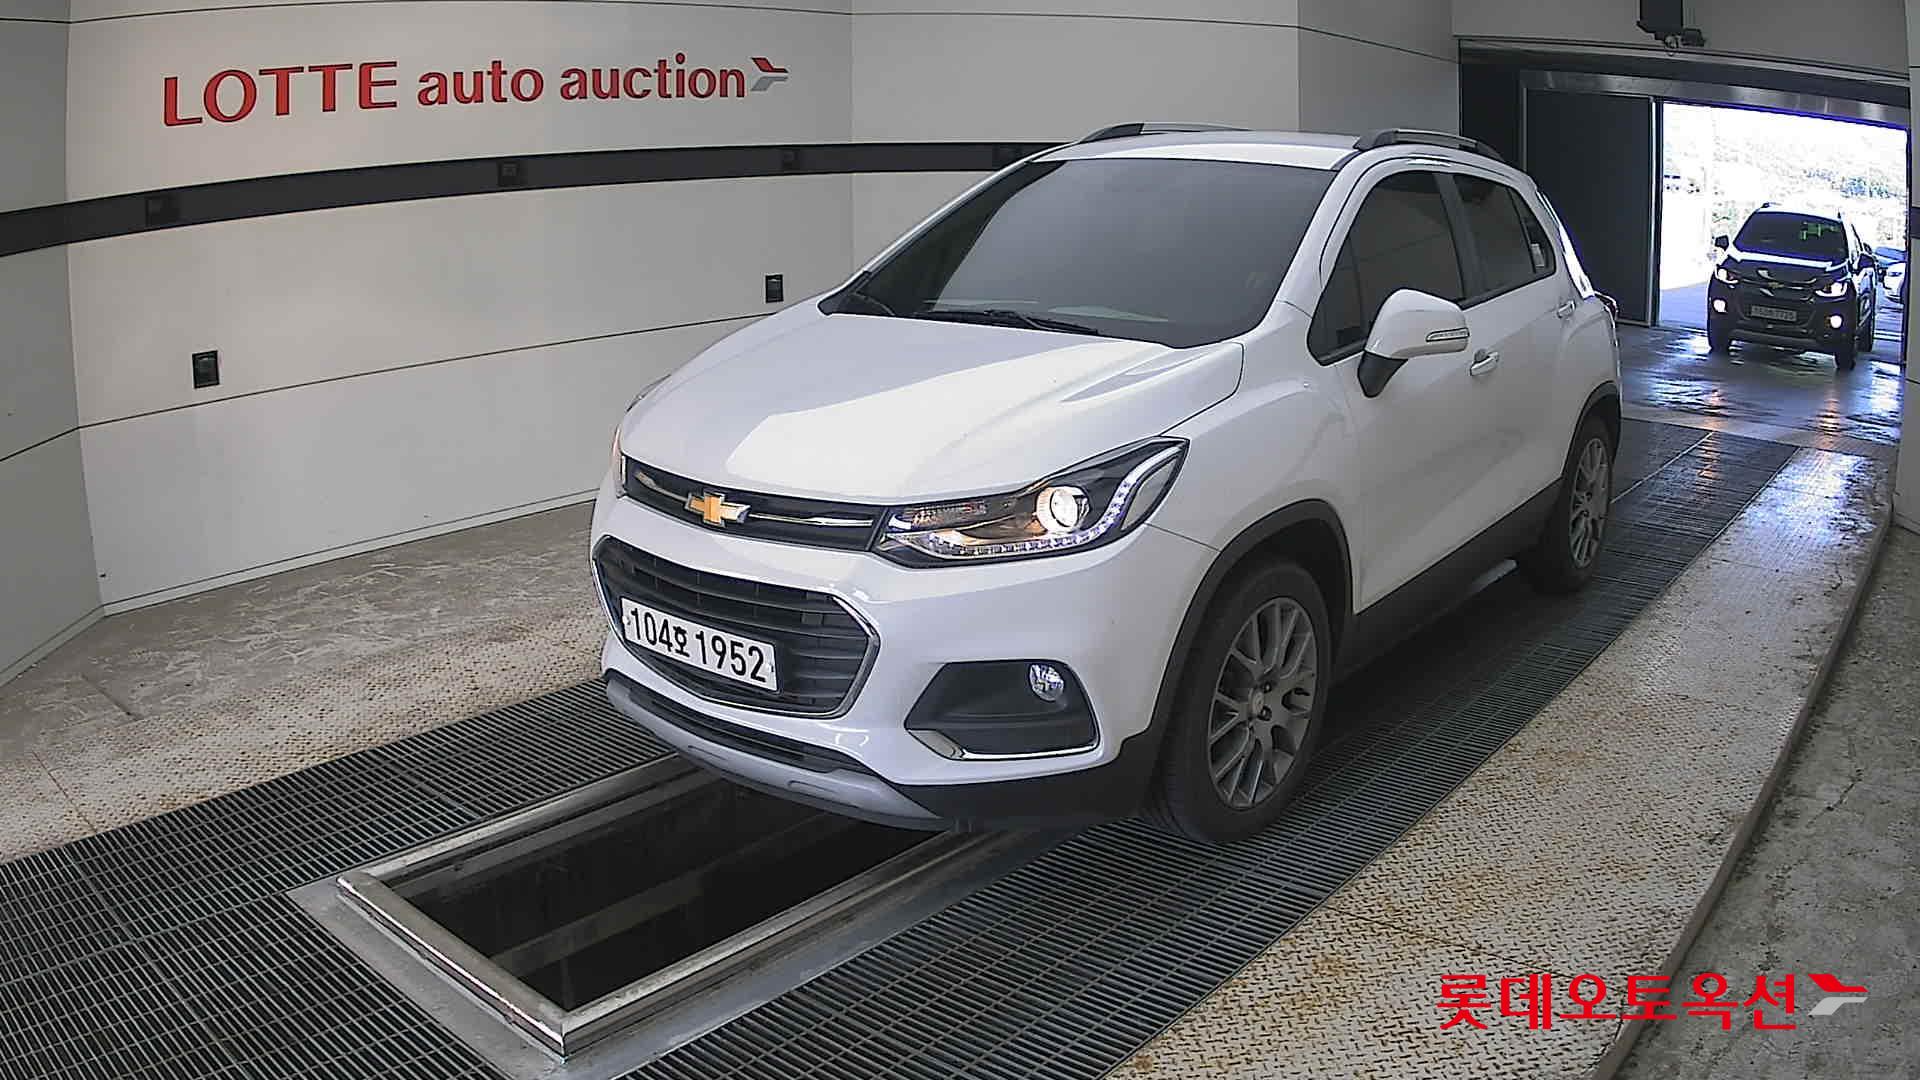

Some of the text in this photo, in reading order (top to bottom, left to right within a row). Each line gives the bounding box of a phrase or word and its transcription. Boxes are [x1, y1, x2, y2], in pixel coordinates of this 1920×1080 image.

[163, 52, 746, 127] LOTTE auto auction
[631, 607, 767, 684] 104호 1952
